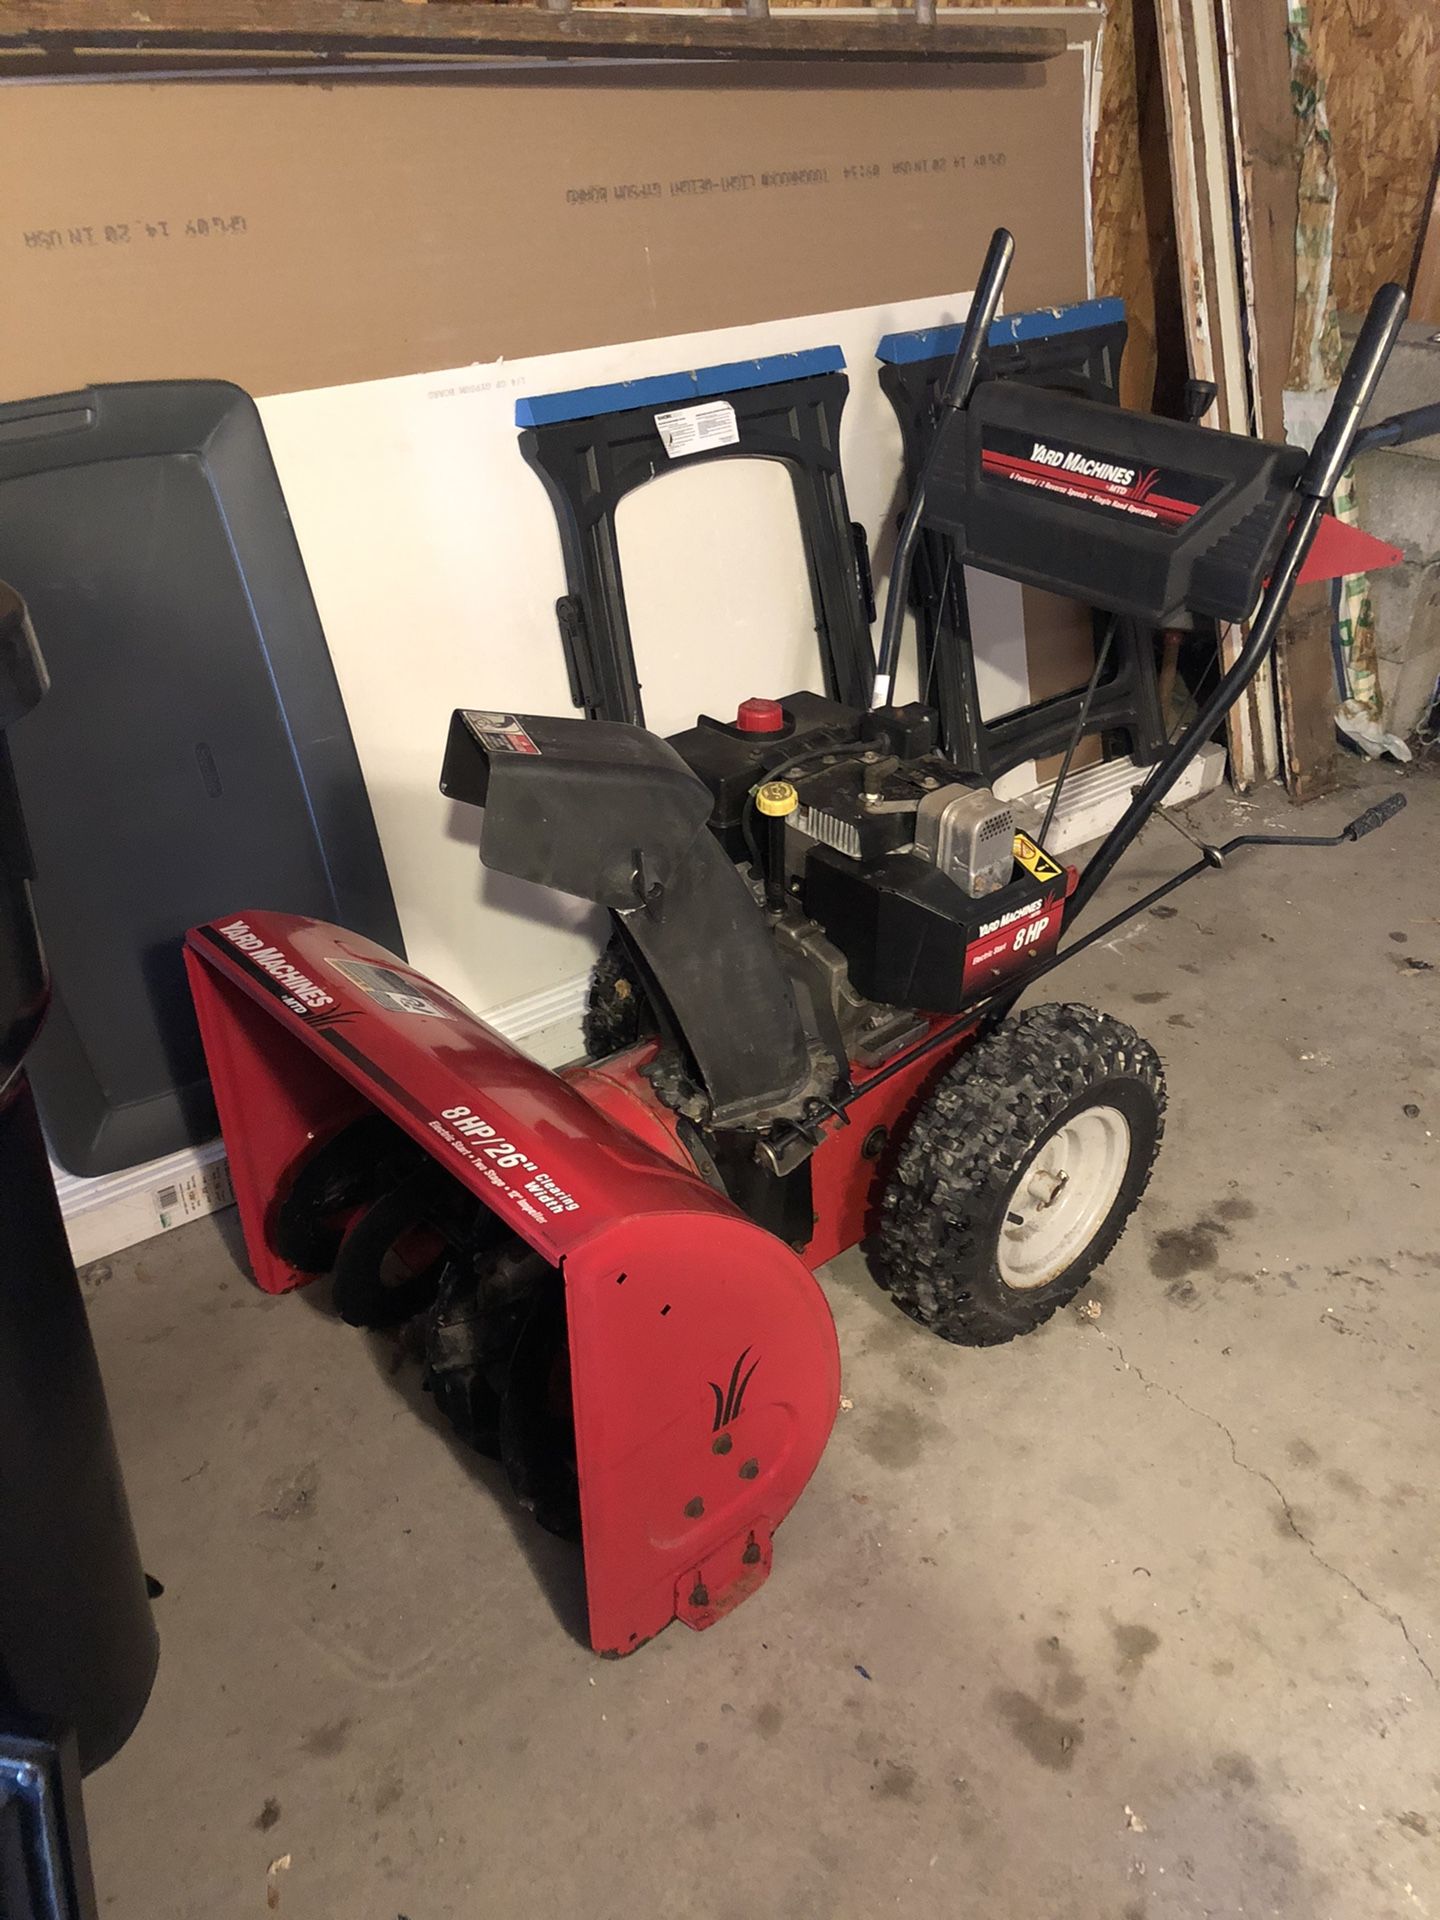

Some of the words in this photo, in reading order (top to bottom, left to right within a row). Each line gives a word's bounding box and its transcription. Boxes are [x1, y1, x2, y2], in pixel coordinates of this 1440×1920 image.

[23, 229, 63, 250] USA
[68, 226, 97, 246] IN
[104, 223, 130, 244] 20
[1029, 442, 1064, 468] YARD
[1063, 452, 1135, 486] MACHINES
[1014, 473, 1036, 486] Forward
[1045, 480, 1067, 494] Reverse
[1092, 494, 1111, 507] Single
[1127, 504, 1158, 518] Operation
[979, 919, 1000, 938] YARD
[1000, 899, 1043, 928] MACHINES
[218, 920, 264, 951] YARD
[249, 947, 334, 1008] MACHINES
[284, 997, 307, 1014] MTD
[428, 1120, 456, 1142] Electric
[451, 1140, 472, 1157] Start
[471, 1158, 488, 1172] Two
[484, 1168, 506, 1188] Stage
[516, 1198, 548, 1224] Impeller
[524, 1180, 564, 1214] Width
[535, 1173, 580, 1212] Clearing
